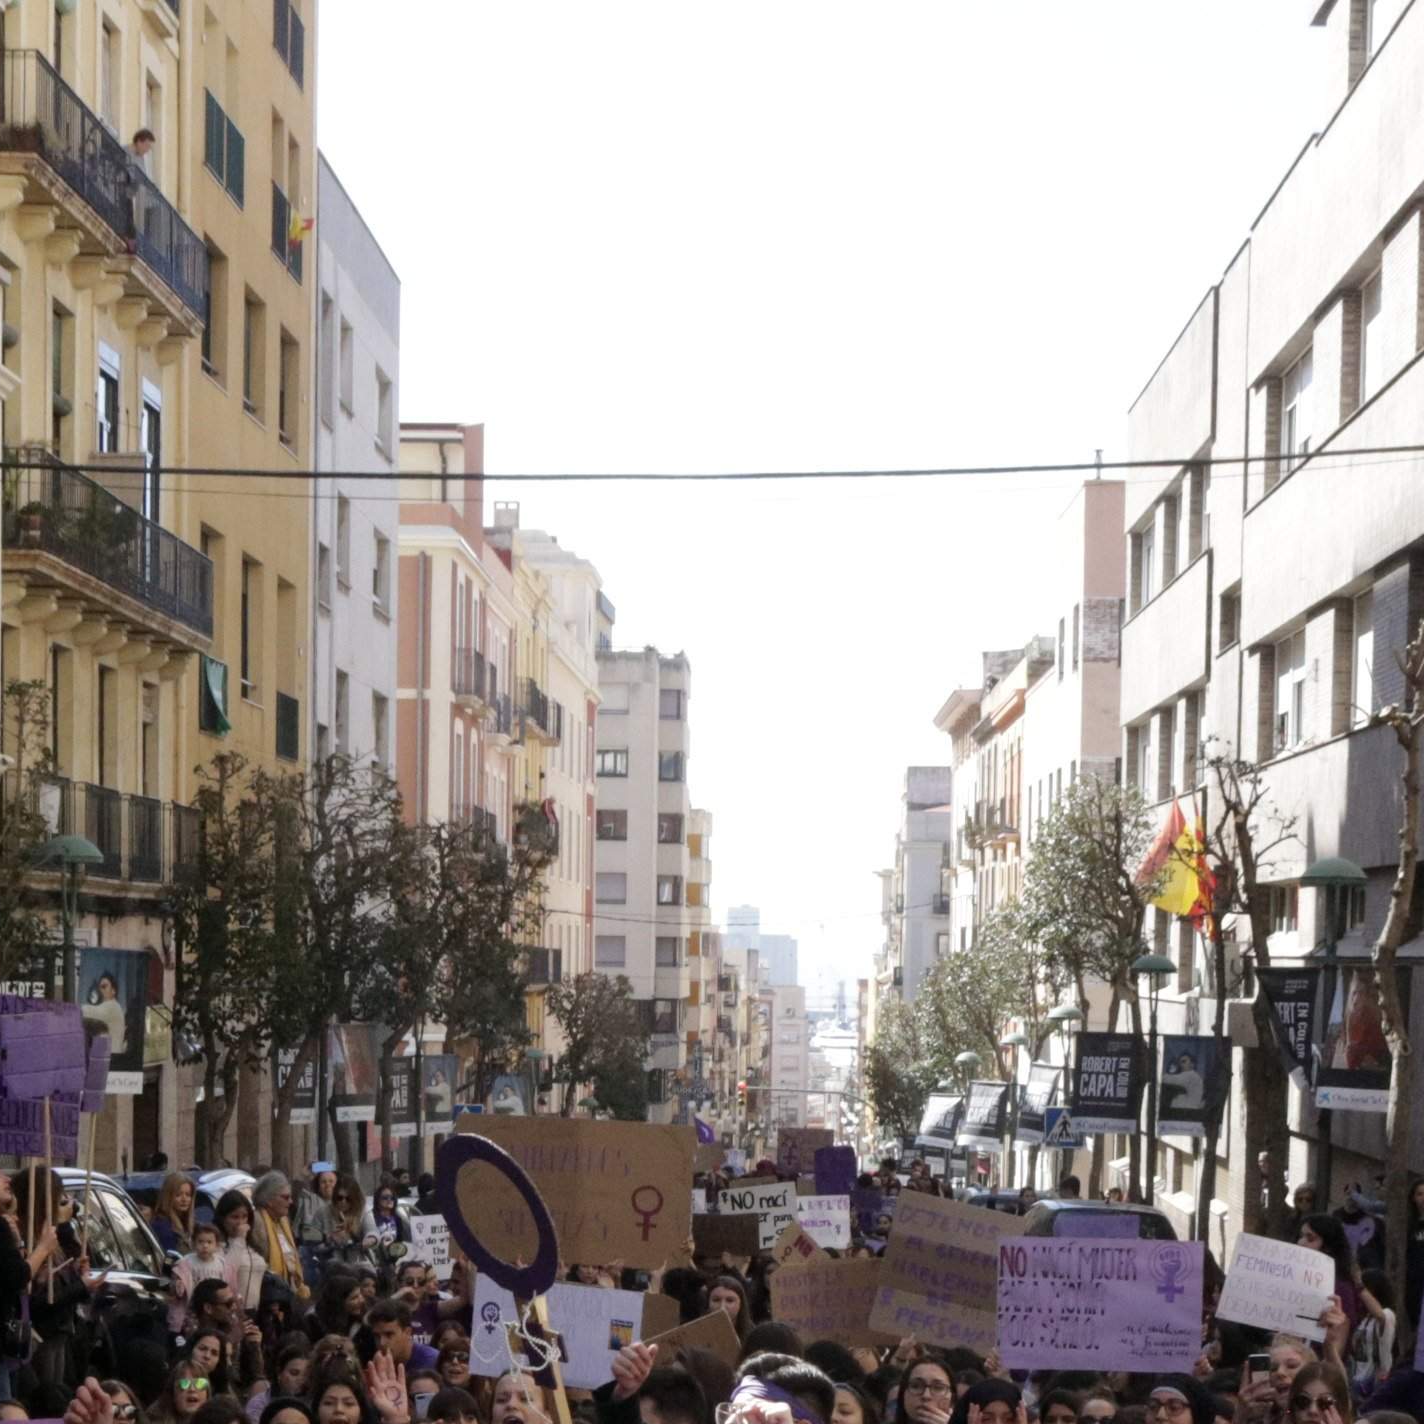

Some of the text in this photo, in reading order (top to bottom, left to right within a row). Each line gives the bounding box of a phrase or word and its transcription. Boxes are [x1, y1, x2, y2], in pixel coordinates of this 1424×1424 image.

[1082, 1056, 1118, 1073] ROBERT
[1079, 1074, 1115, 1098] CAPA
[730, 1192, 754, 1211] NO
[759, 1189, 787, 1209] nací
[999, 1246, 1026, 1278] NO
[1078, 1247, 1137, 1280] MUJER
[1237, 1254, 1293, 1280] FEMINISTA
